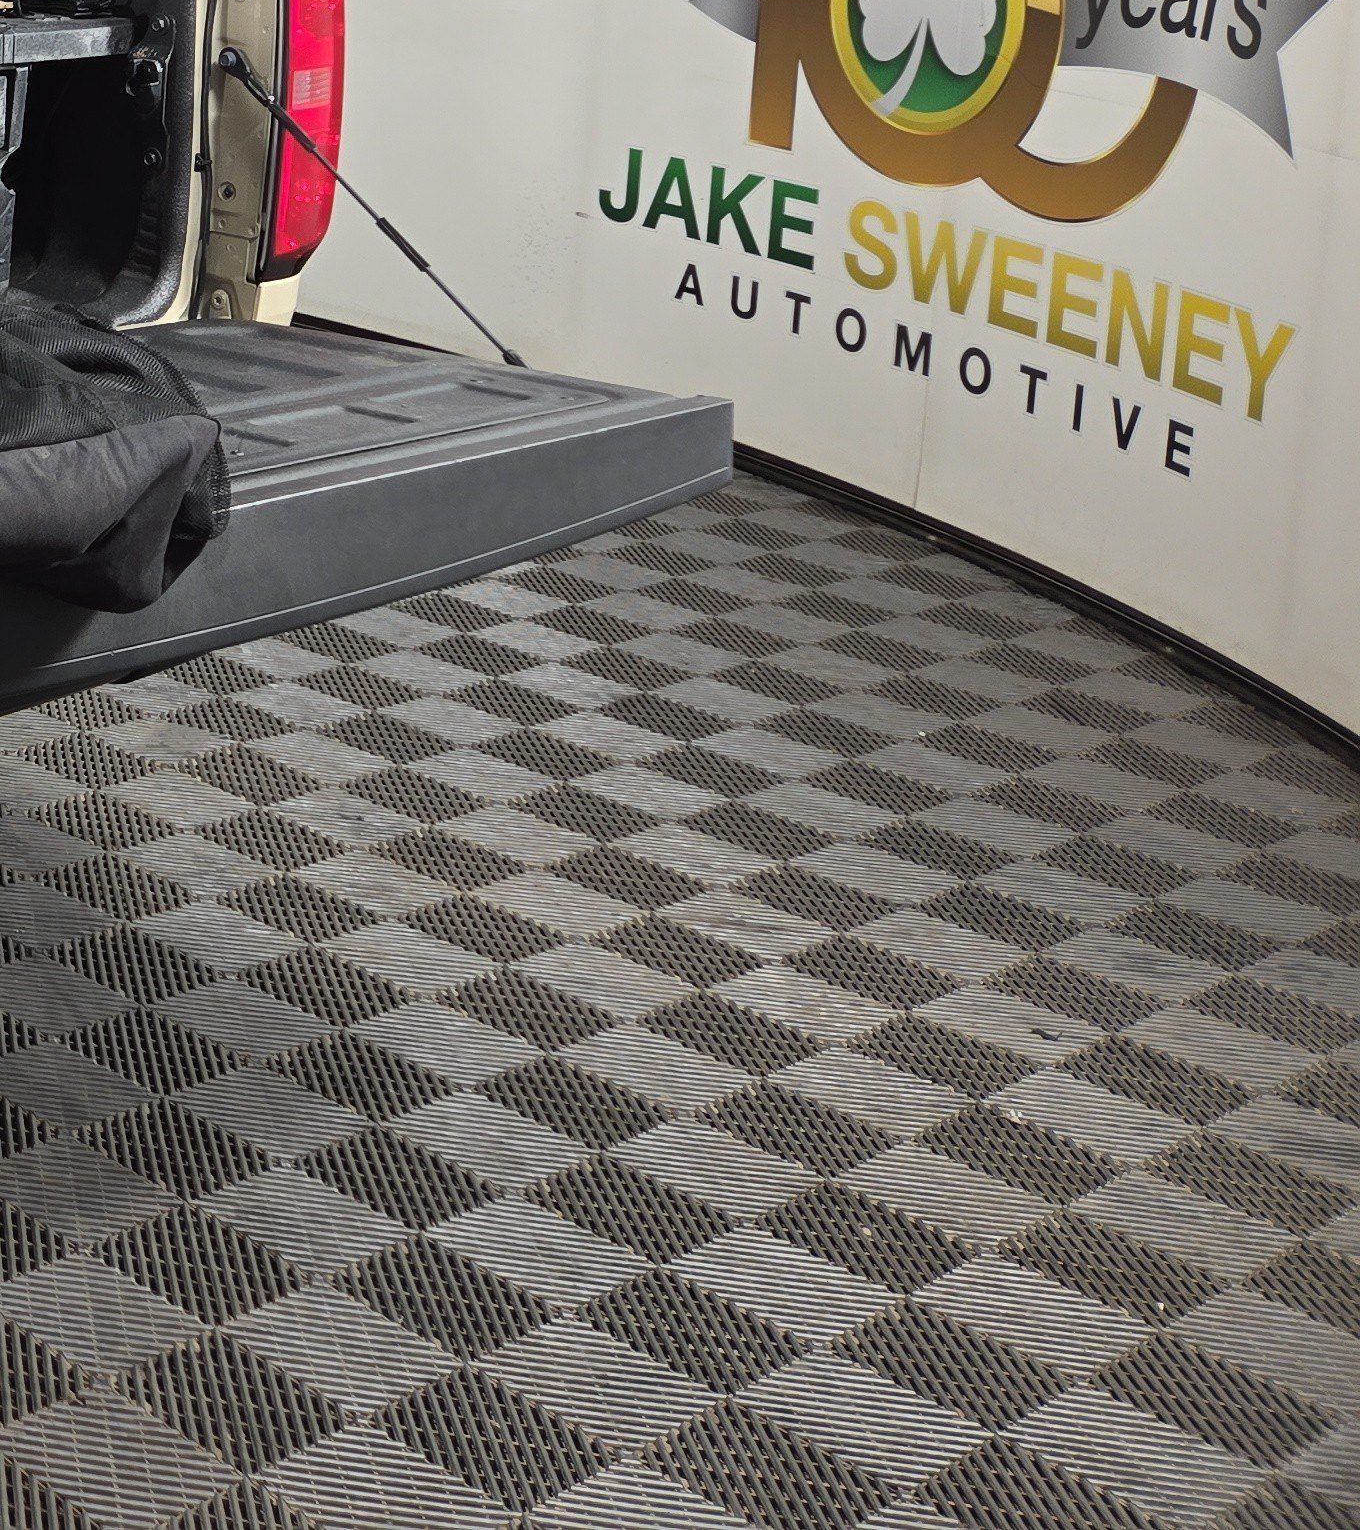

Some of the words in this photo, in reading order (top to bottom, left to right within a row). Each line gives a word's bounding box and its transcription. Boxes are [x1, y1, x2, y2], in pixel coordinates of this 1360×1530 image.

[598, 148, 820, 271] JAKE
[843, 199, 1297, 422] SWEENEY
[675, 263, 1195, 477] AUTOMOTIVE
